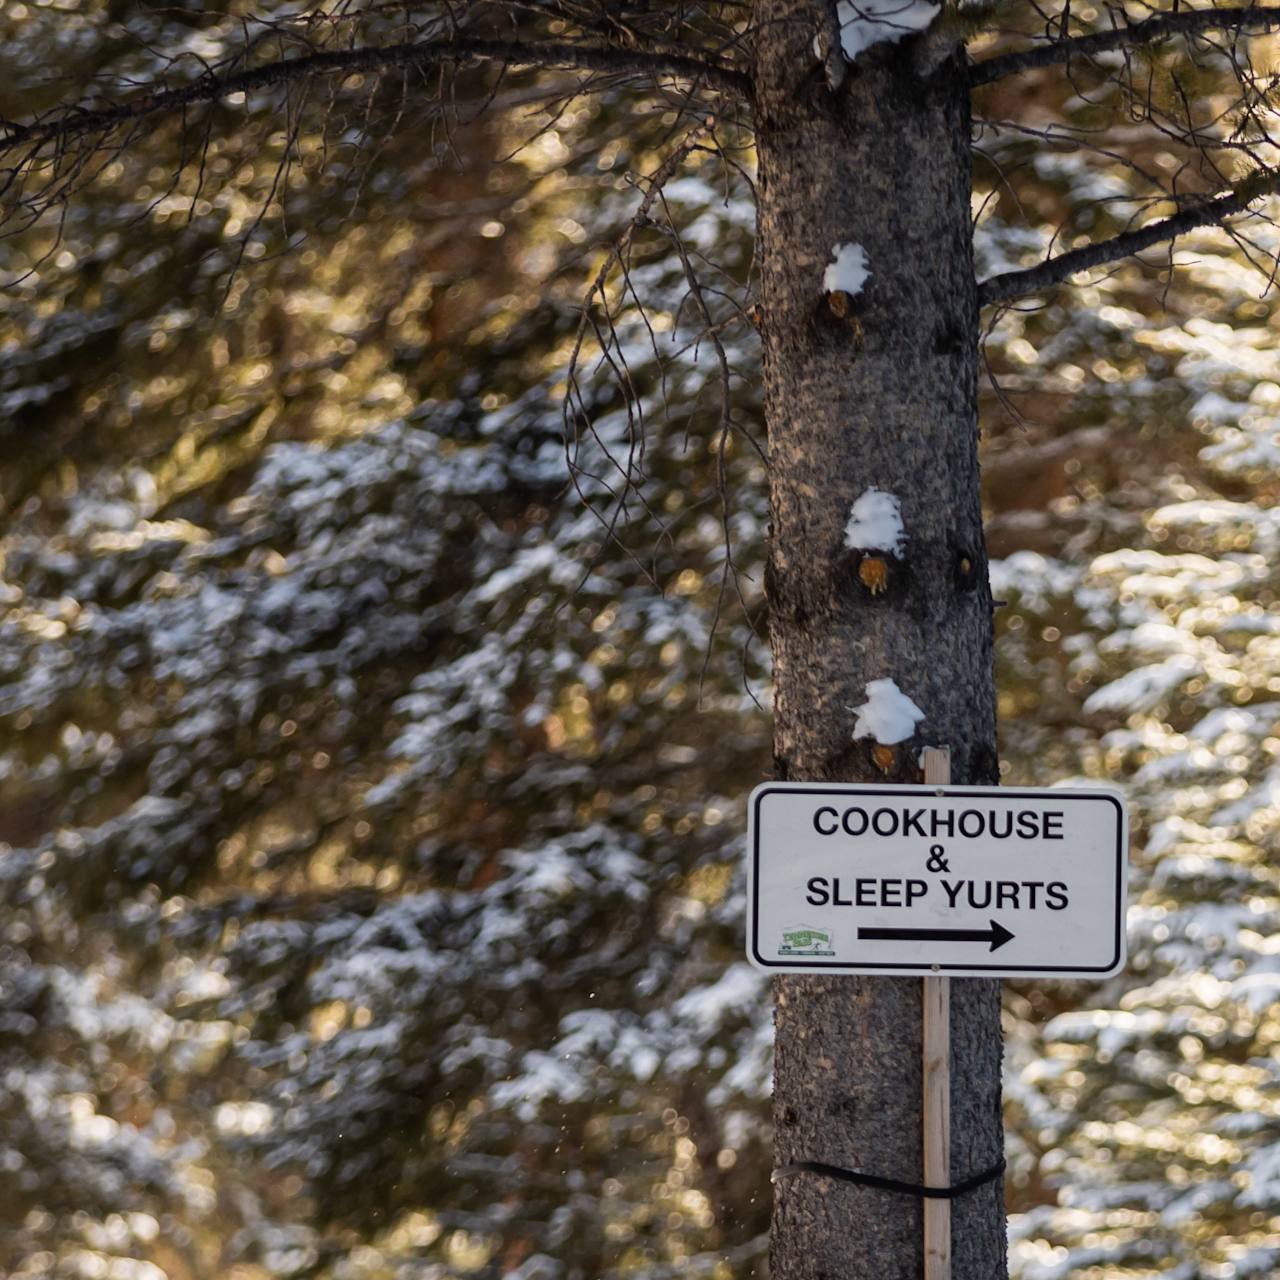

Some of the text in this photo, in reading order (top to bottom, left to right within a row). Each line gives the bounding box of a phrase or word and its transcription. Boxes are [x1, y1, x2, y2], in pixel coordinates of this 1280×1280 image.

[812, 806, 1064, 840] COOKHOUSE
[925, 844, 951, 873] &
[806, 876, 1070, 911] SLEEP YURTS
